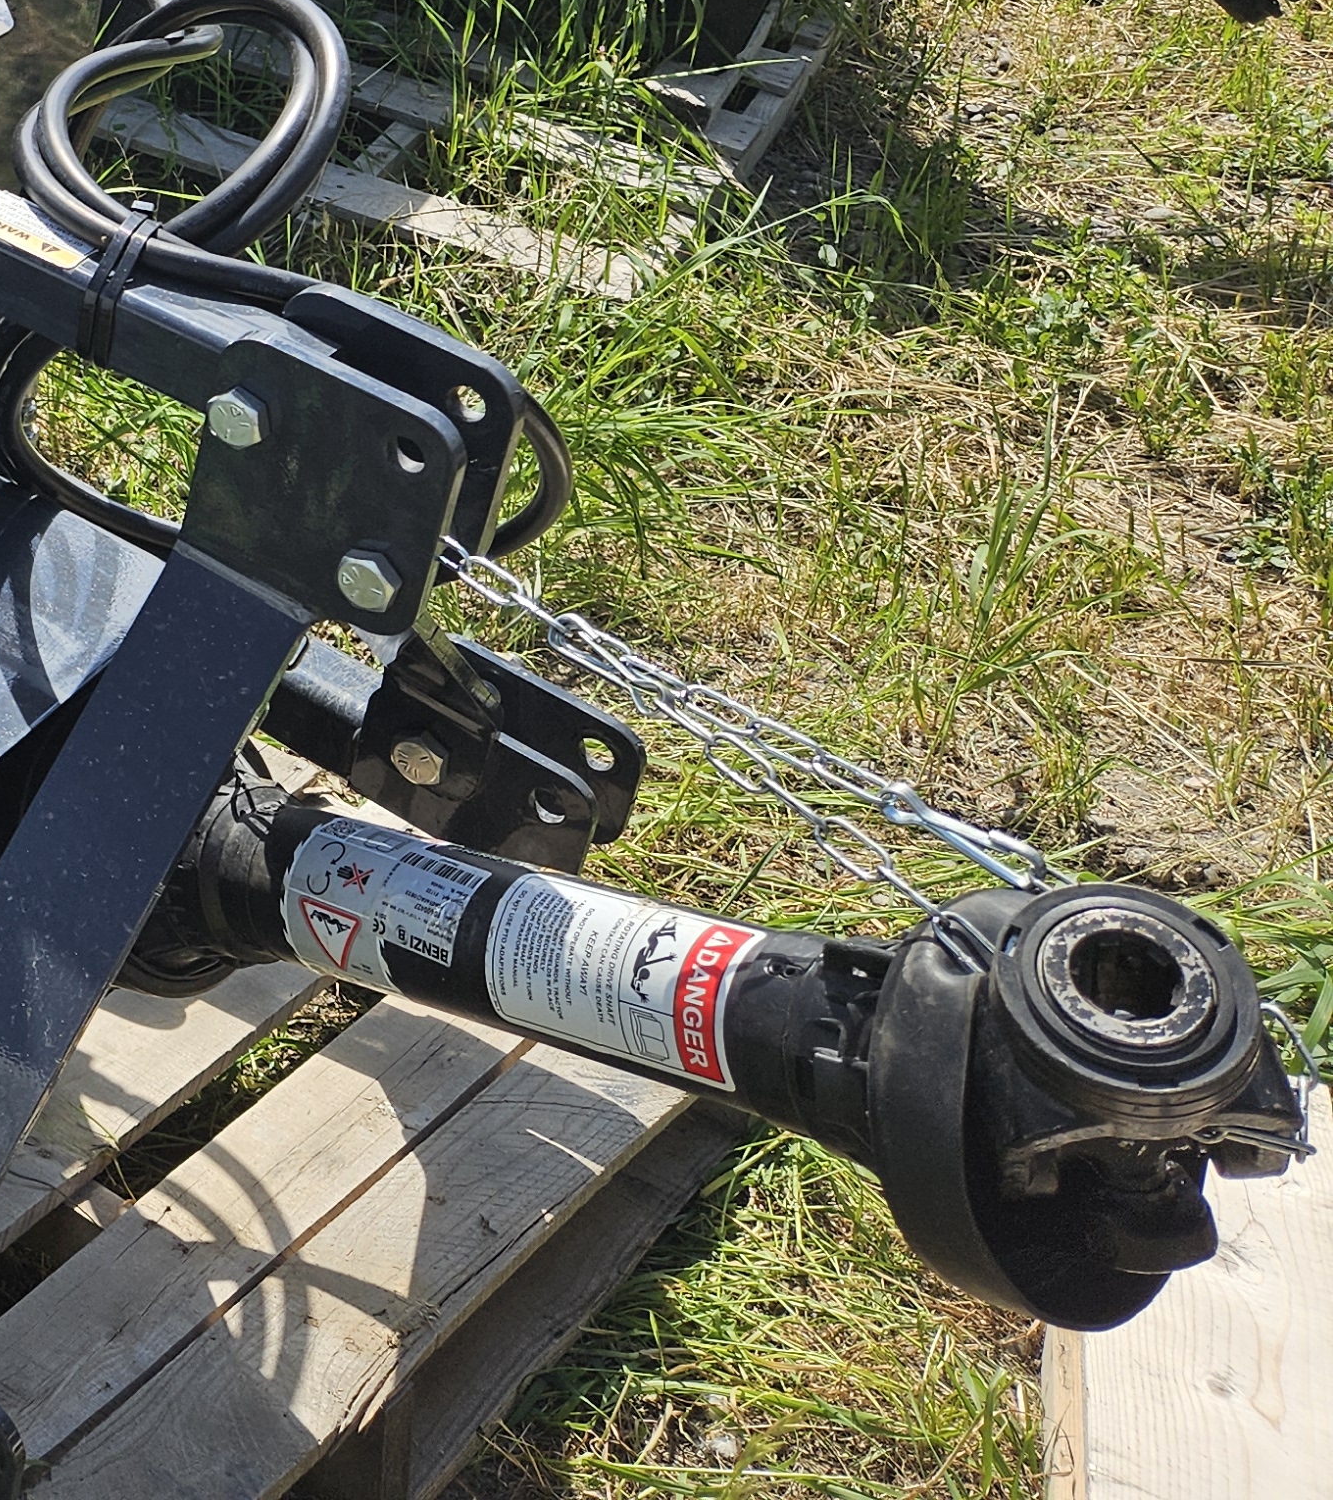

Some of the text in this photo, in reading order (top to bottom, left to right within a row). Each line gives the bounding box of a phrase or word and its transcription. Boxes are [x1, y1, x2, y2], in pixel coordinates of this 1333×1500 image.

[510, 899, 520, 911] NOT
[517, 889, 527, 898] DO
[505, 911, 514, 926] USE
[576, 917, 588, 930] NOT
[585, 907, 595, 917] DO
[500, 927, 510, 944] PTO
[408, 934, 448, 963] BENZI
[565, 931, 580, 966] OPERATE
[579, 930, 599, 996] KEEP AWAY!
[594, 917, 624, 1023] CONTACT CAN CAUSE DEATH
[604, 920, 634, 1026] ROTATING DRIVE SHAFT
[683, 947, 717, 1069] DANGER
